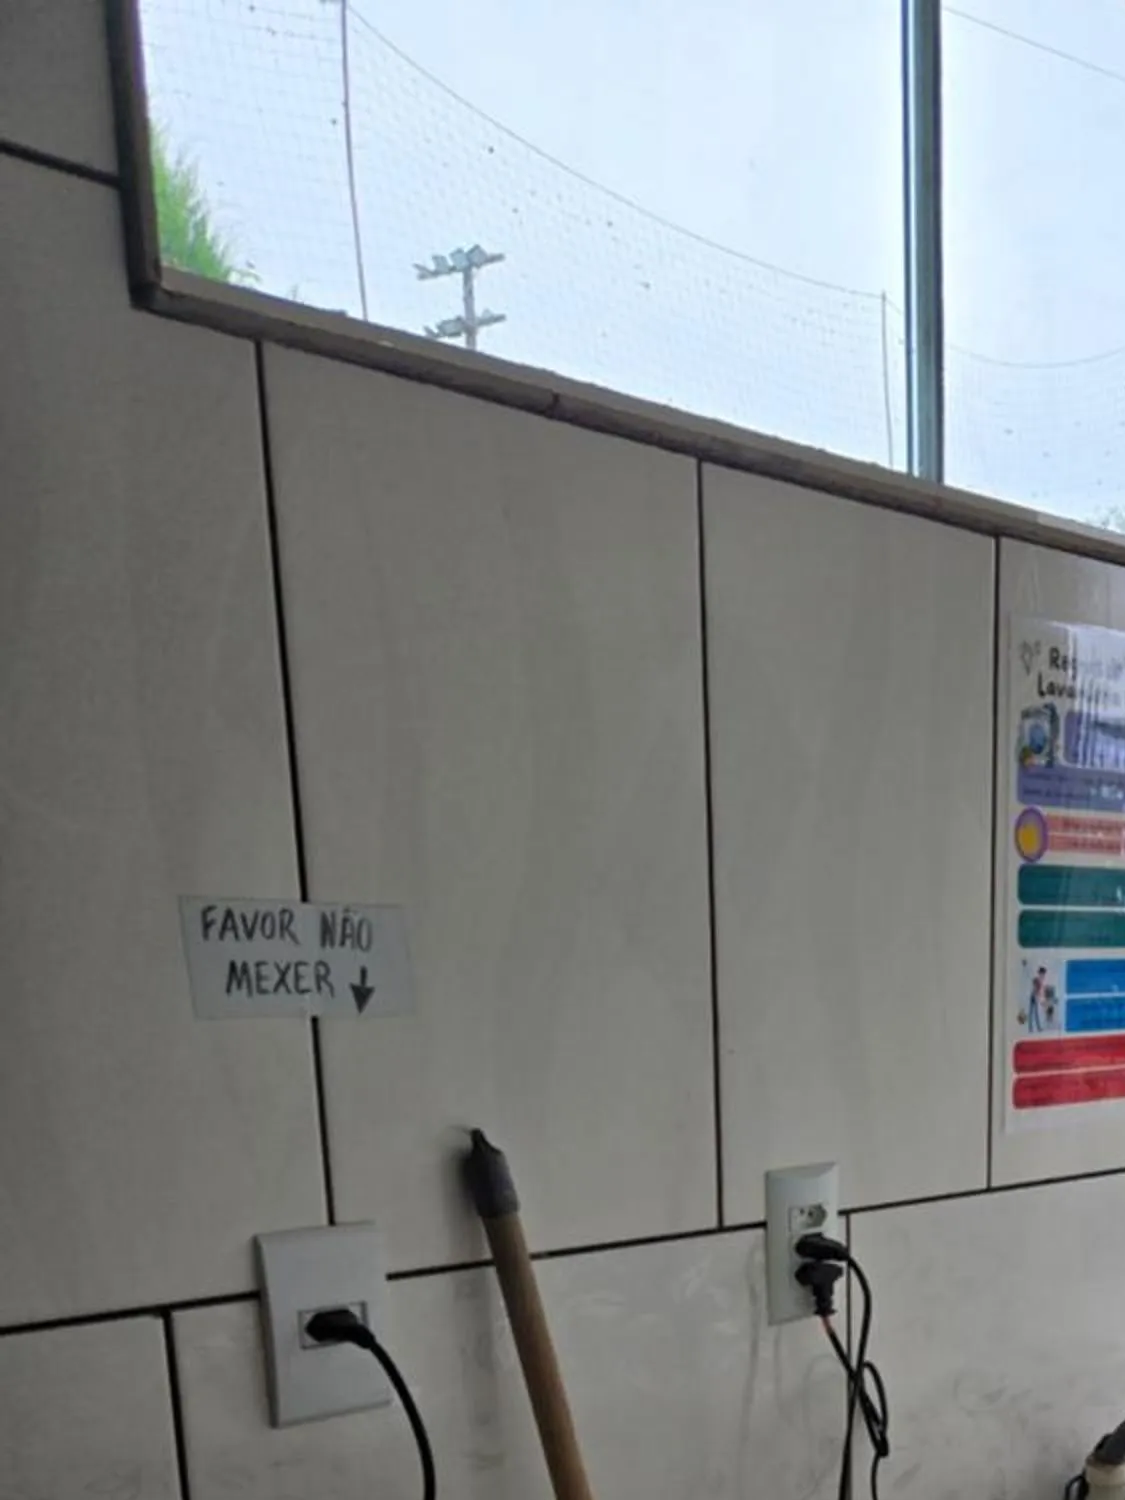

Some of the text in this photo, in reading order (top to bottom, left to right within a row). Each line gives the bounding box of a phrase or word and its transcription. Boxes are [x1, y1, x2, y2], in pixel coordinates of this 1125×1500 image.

[201, 904, 373, 952] FAVOR NÃO
[225, 959, 336, 999] MEXER
